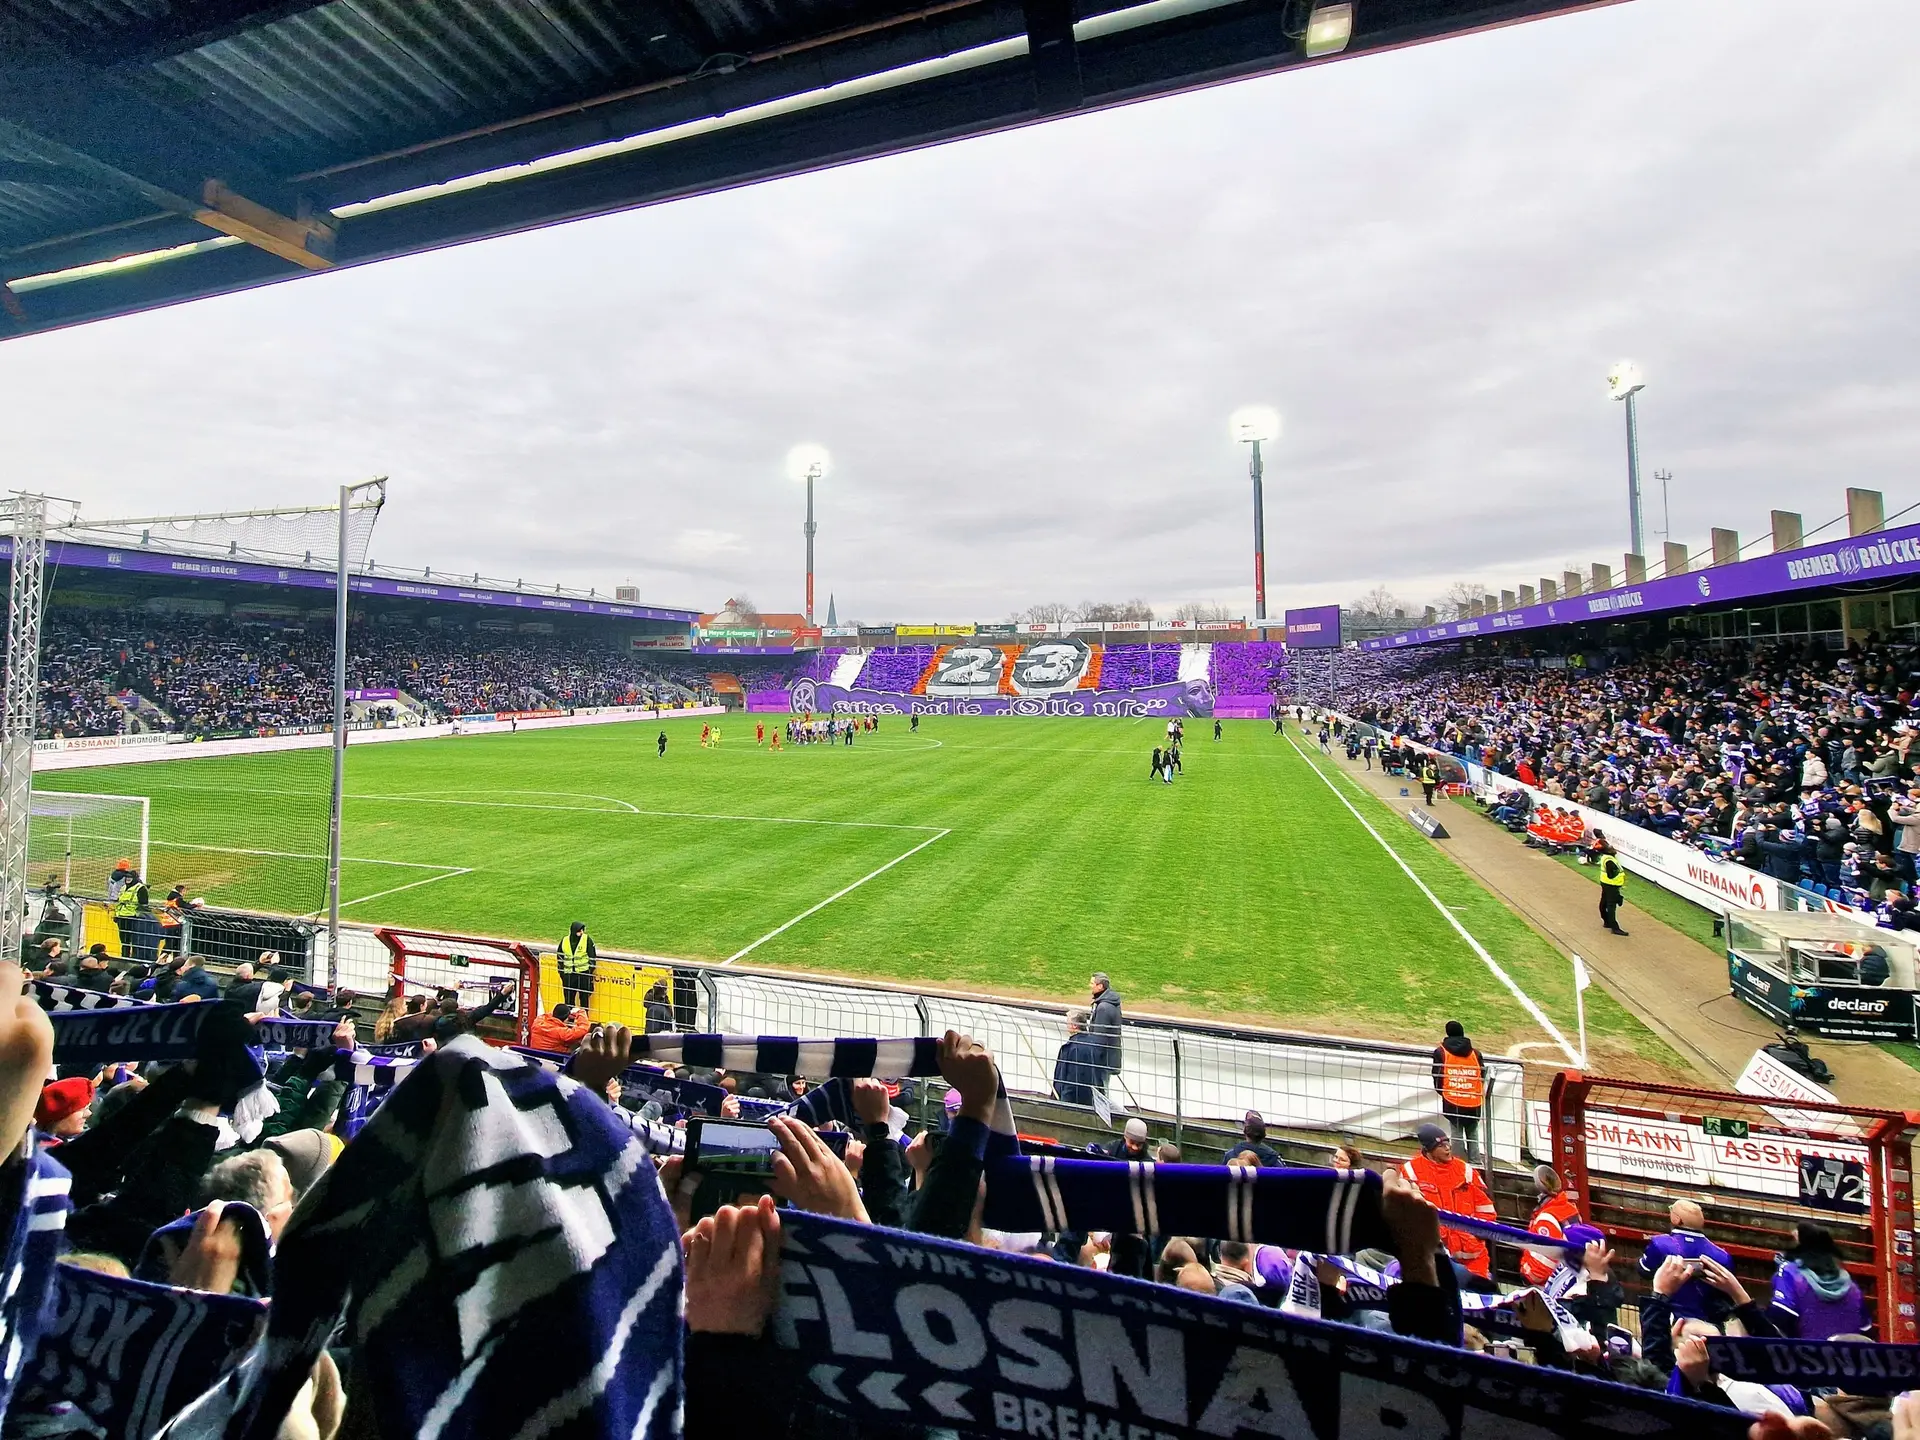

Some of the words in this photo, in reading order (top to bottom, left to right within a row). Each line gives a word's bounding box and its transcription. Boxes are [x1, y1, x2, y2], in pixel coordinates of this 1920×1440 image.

[1786, 553, 1840, 580] BREMER
[1858, 538, 1920, 569] BRÜCKE
[1588, 598, 1610, 613] BREMER
[1618, 590, 1642, 609] BRÜCKE
[1112, 621, 1140, 631] pante
[67, 739, 117, 749] ASSMANN
[121, 735, 166, 745] BÜROMÖBEL
[1687, 863, 1748, 902] WIEMANN
[1746, 971, 1772, 992] declaro
[1828, 997, 1887, 1013] declaro
[1447, 1068, 1477, 1077] ORANGE
[1547, 1121, 1683, 1152] SMANN
[1620, 1153, 1700, 1177] BÜROMÖBEL
[1724, 1140, 1872, 1176] ASSM
[773, 1260, 893, 1361] FL
[1708, 1341, 1757, 1376] FL
[1765, 1342, 1920, 1379] OSNAB
[991, 1391, 1181, 1440] BREM
